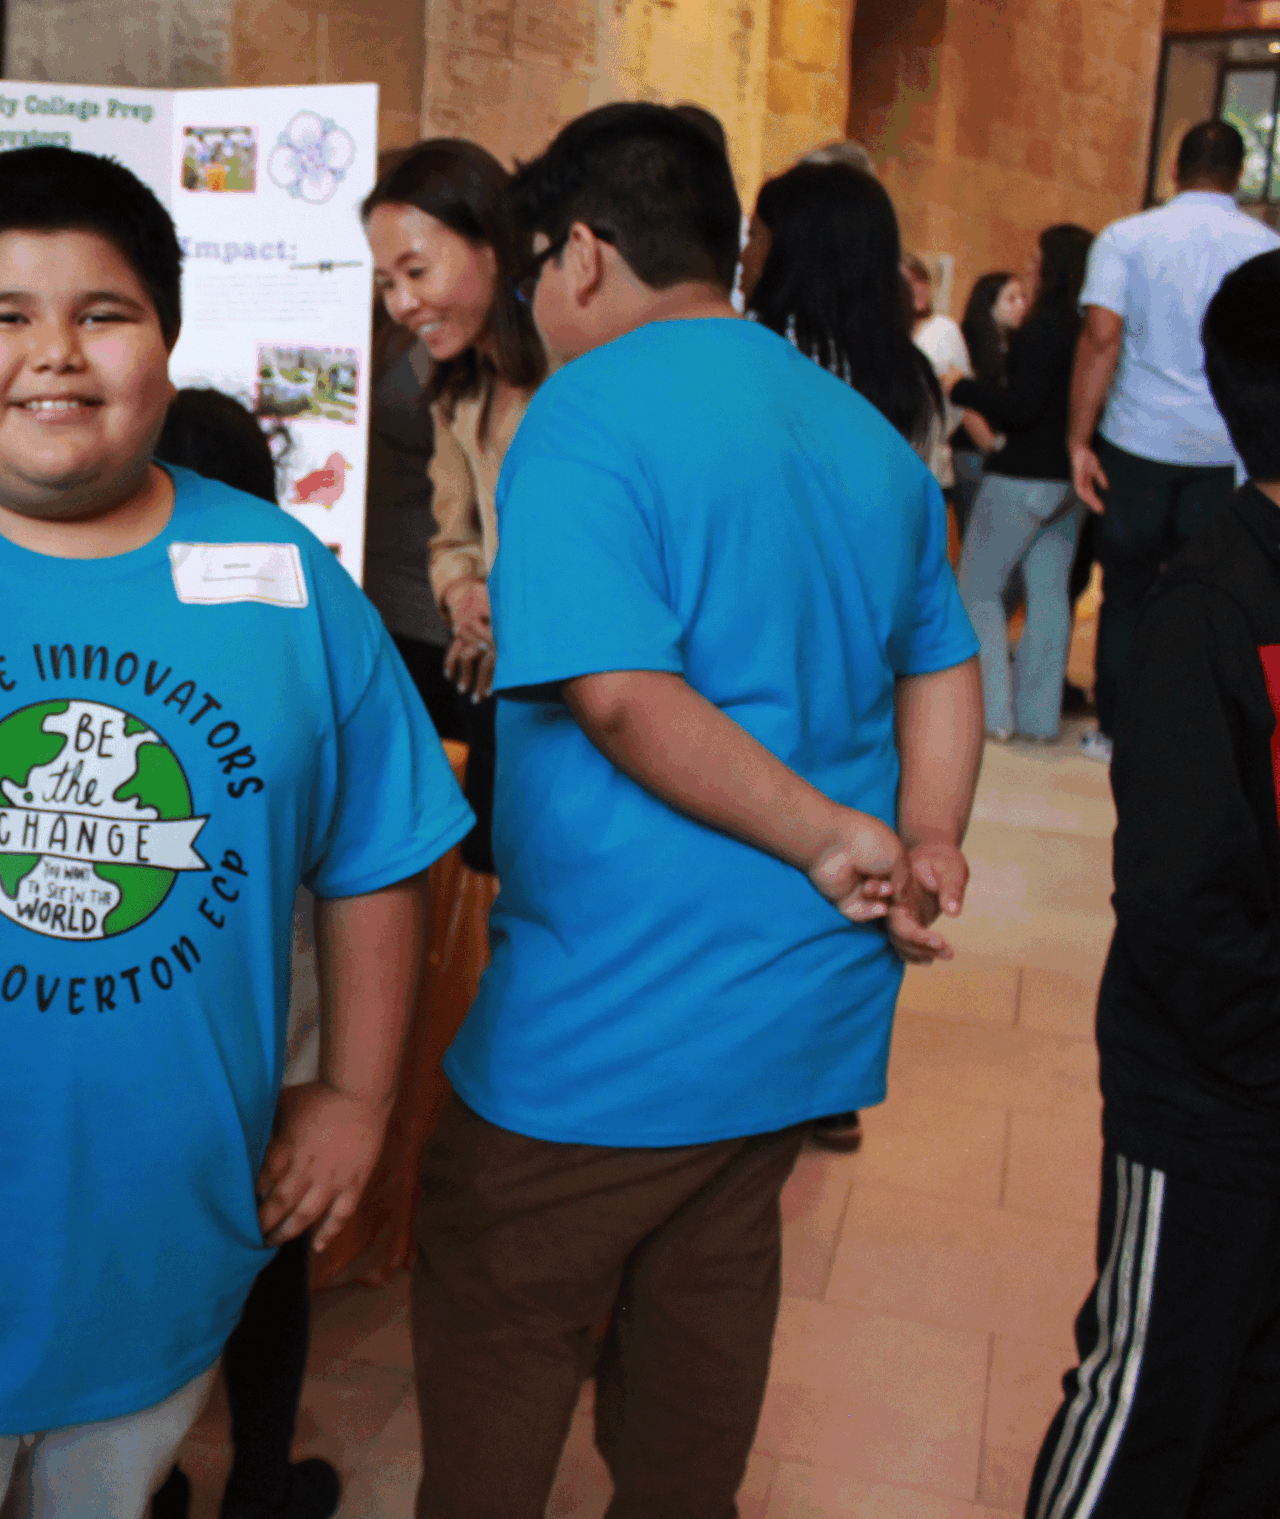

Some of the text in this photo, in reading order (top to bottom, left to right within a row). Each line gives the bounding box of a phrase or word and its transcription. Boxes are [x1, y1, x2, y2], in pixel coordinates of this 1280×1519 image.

[24, 94, 100, 122] College
[107, 98, 154, 123] Prep
[32, 643, 264, 800] INNOVATORS
[73, 713, 114, 759] BE
[41, 759, 106, 807] the
[1, 935, 202, 1016] OVERTON
[197, 848, 250, 930] ECP
[16, 897, 97, 935] WORLD
